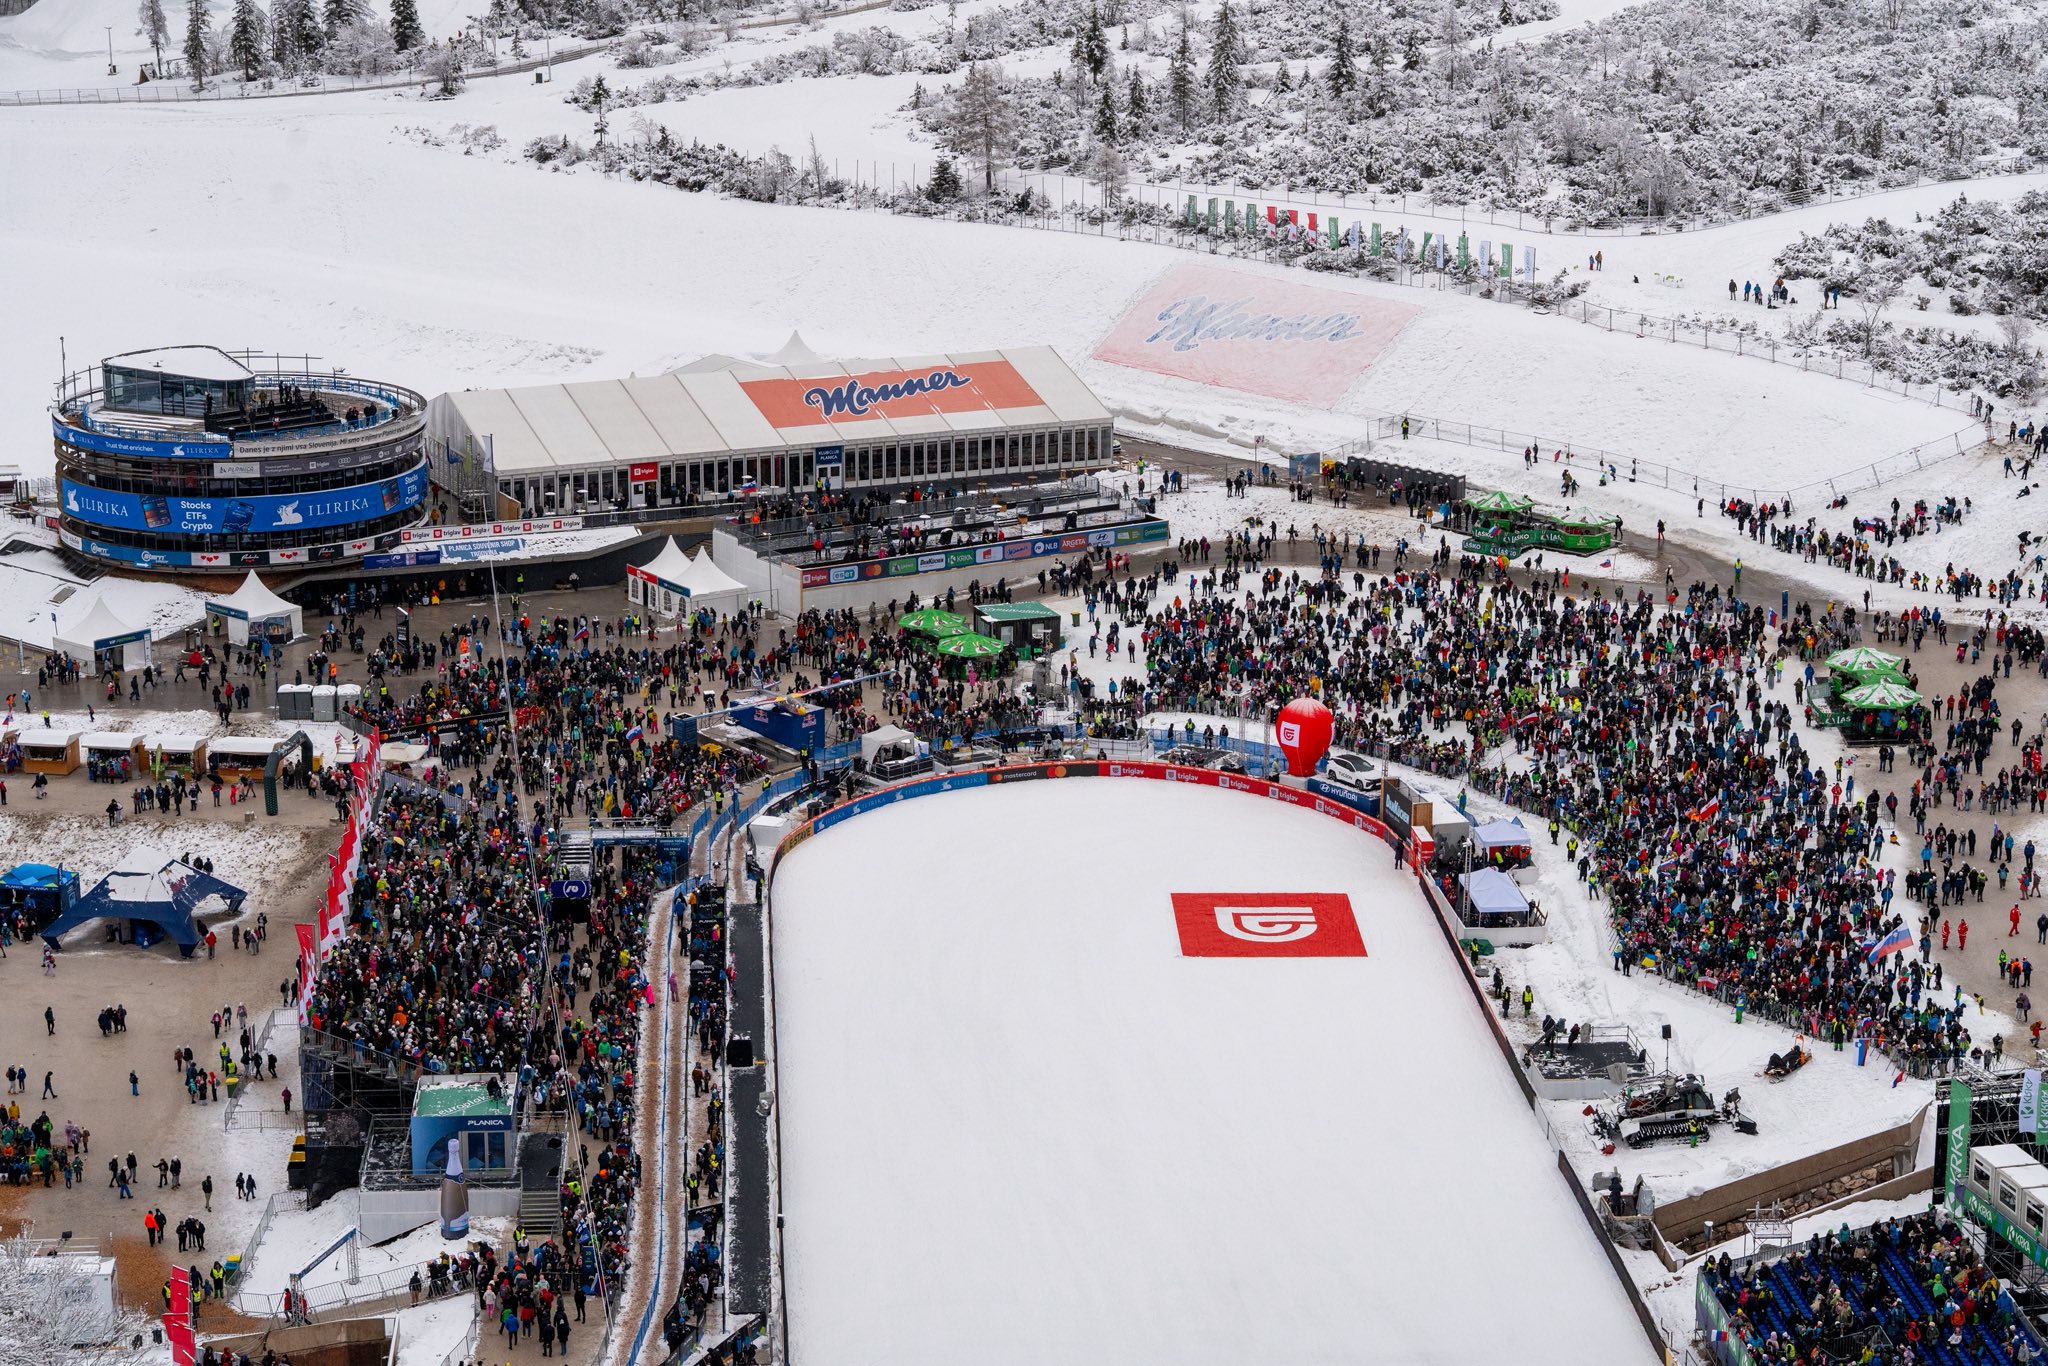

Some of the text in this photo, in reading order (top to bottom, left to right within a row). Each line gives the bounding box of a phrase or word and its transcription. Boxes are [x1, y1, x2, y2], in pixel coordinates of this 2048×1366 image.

[803, 371, 972, 417] Manner
[105, 440, 118, 449] Trust
[118, 443, 129, 451] that
[186, 446, 219, 455] ILIRIKA
[239, 445, 262, 454] Danes
[263, 445, 270, 454] je
[277, 443, 294, 452] njimi
[308, 440, 339, 450] Slovenija.
[404, 474, 419, 485] Stocks
[407, 486, 418, 495] ETFs
[180, 500, 212, 510] Stocks
[404, 494, 420, 505] Crypto
[80, 497, 128, 517] ILIRIKA
[307, 498, 369, 517] ILIRIKA
[186, 512, 207, 520] ETFs
[181, 521, 213, 533] Crypto
[502, 525, 521, 534] triglav
[532, 522, 550, 531] triglav
[563, 520, 580, 529] triglav
[412, 531, 430, 540] triglav
[443, 529, 461, 538] triglav
[1044, 541, 1058, 550] NLB
[1062, 537, 1086, 548] ARGETA
[956, 554, 973, 562] KRKA
[811, 573, 827, 582] triglav
[1003, 770, 1037, 779] mastercard
[1123, 767, 1145, 776] triglav
[1177, 772, 1199, 781] triglav
[1339, 771, 1353, 779] TUCSON
[953, 776, 984, 786] ILIRIKA
[1229, 779, 1250, 790] triglav
[905, 784, 932, 796] ILIRIKA
[1330, 786, 1358, 801] HYUNDAI
[1279, 791, 1299, 802] triglav
[1324, 804, 1341, 817] triglav
[1363, 820, 1378, 833] triglav
[1949, 1123, 1965, 1185] KRKA
[1978, 1203, 1992, 1223] KRKA
[2015, 1233, 2031, 1254] KRKA
